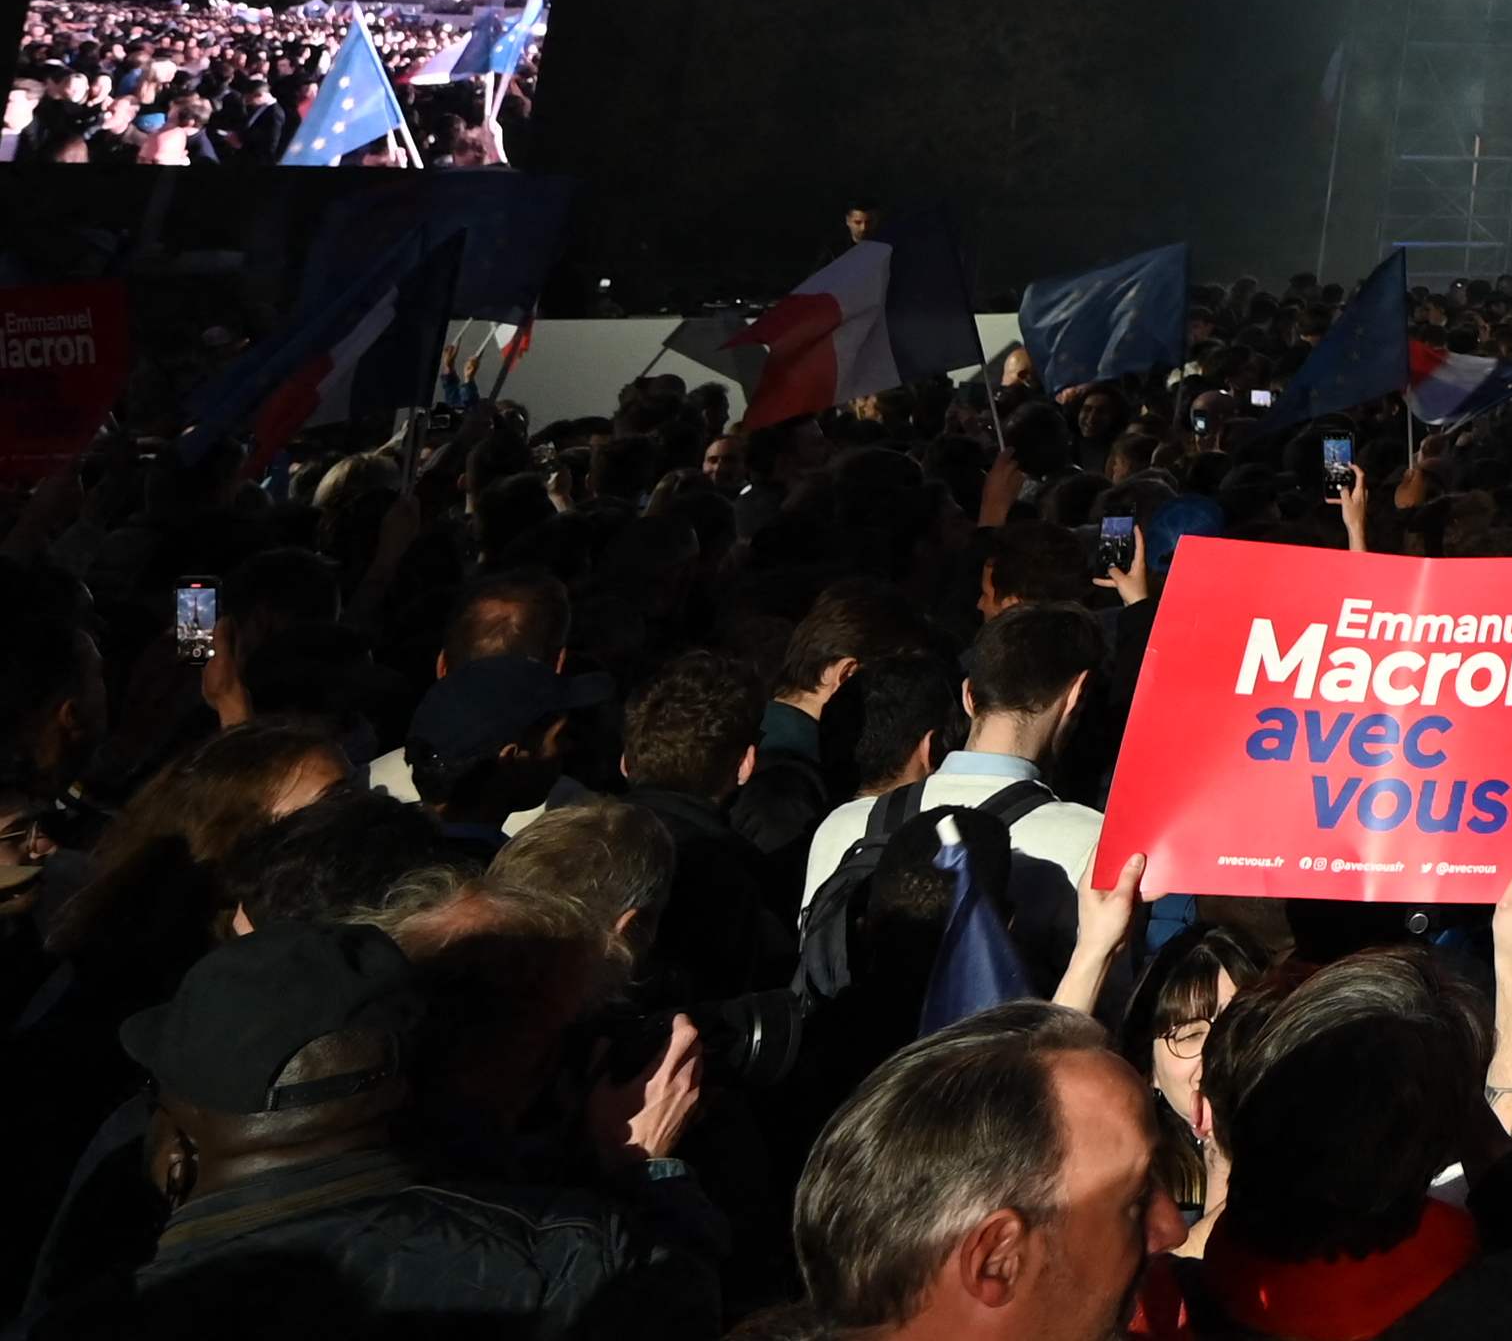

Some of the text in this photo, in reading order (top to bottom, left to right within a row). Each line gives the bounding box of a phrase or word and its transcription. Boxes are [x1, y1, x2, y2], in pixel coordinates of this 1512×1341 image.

[4, 307, 93, 334] Emmanuel
[1246, 707, 1453, 769] avec
[1312, 775, 1510, 834] vous
[1217, 854, 1497, 875] avecvous.fr @avecvousfr @avecvous
